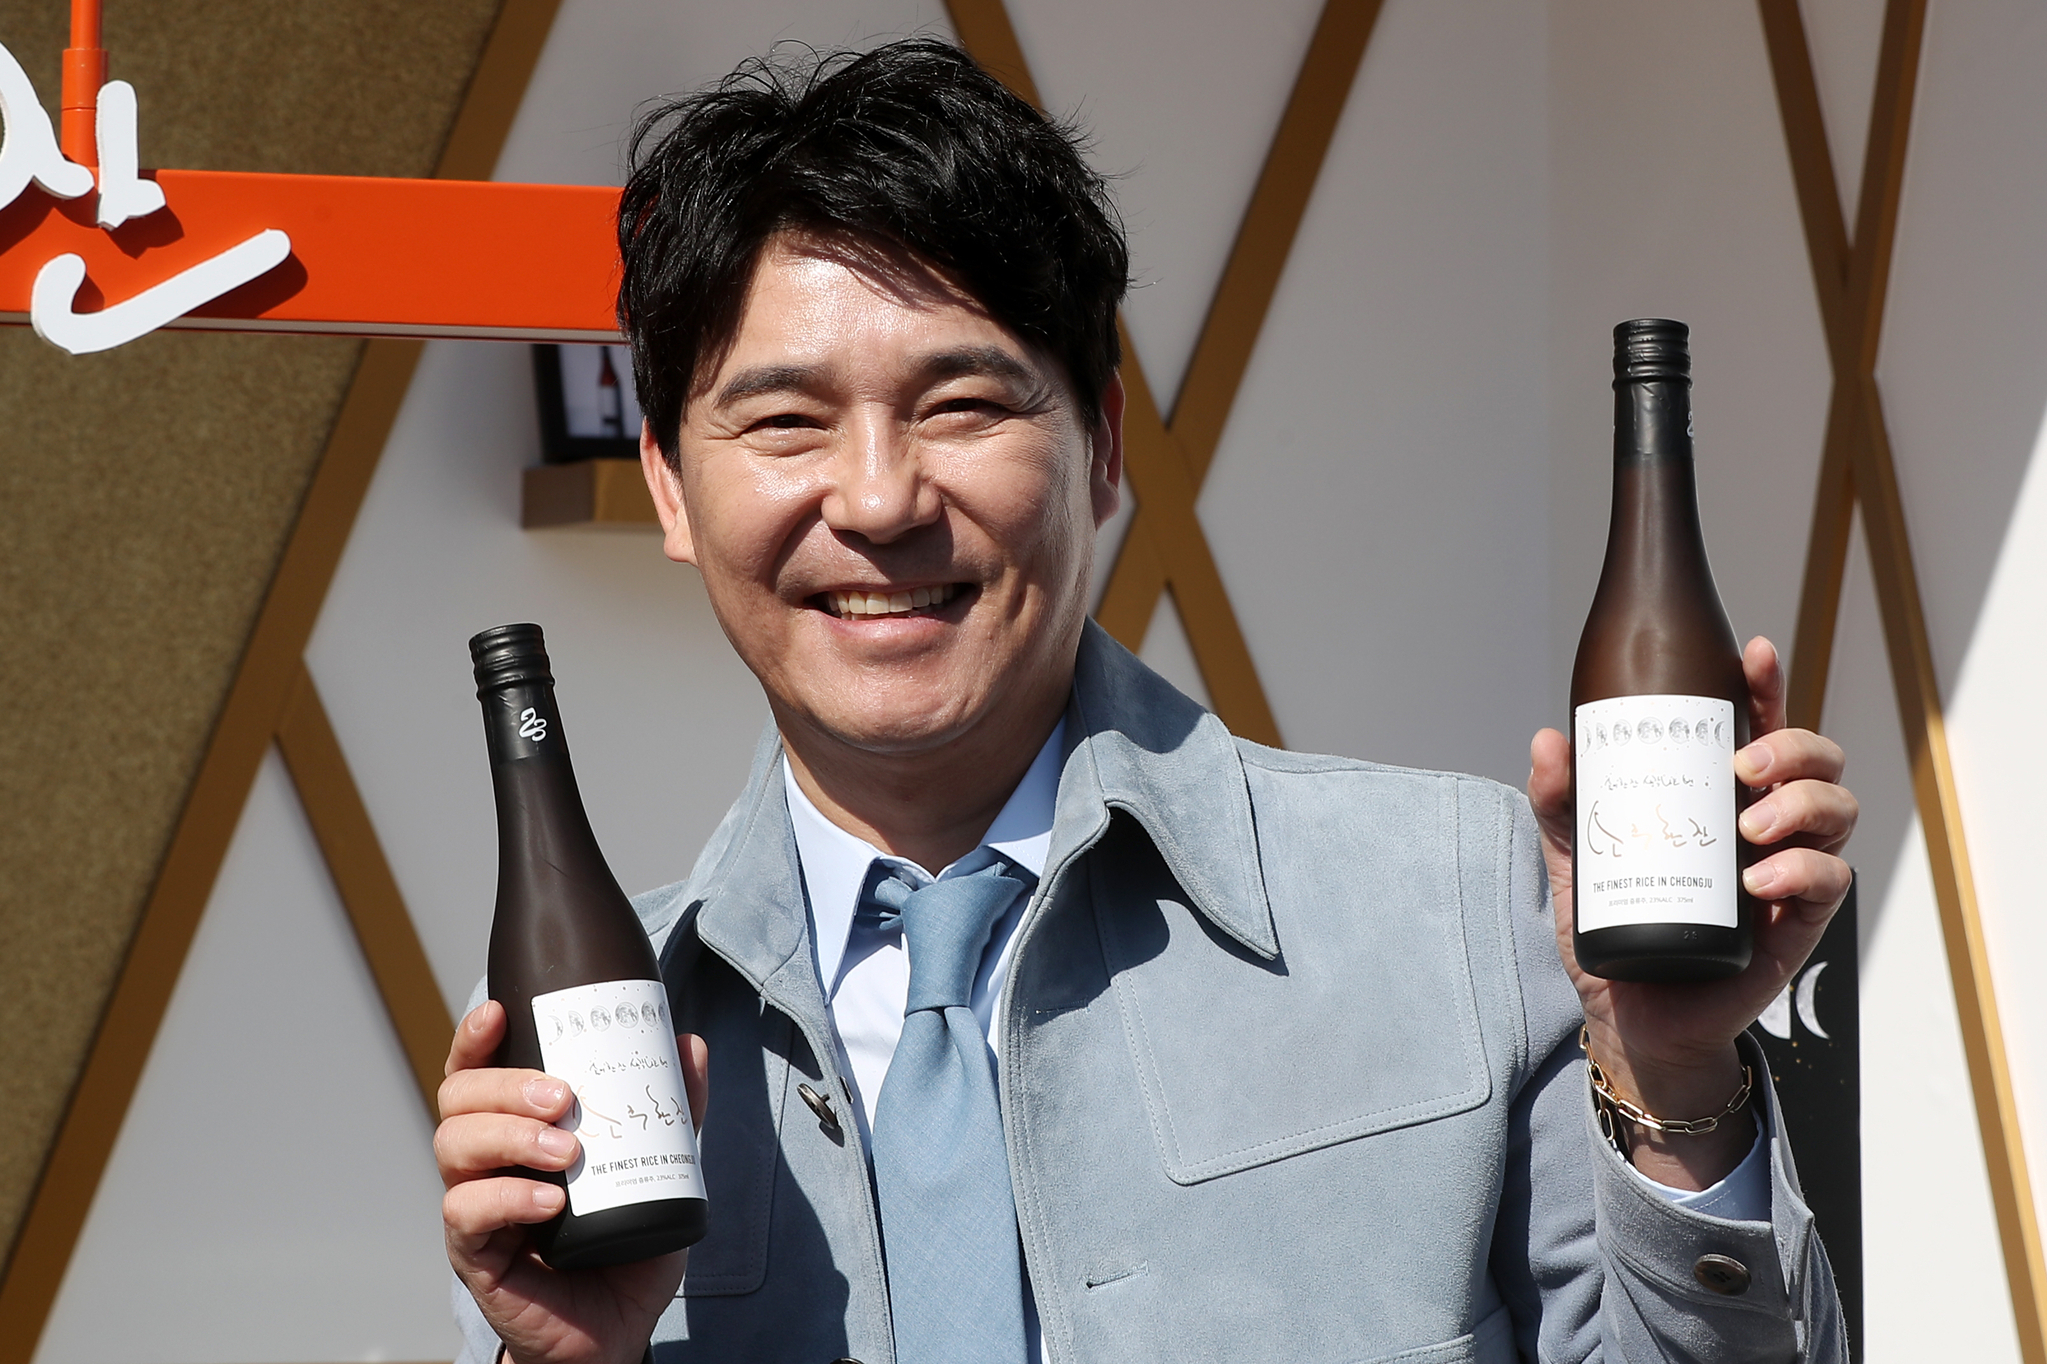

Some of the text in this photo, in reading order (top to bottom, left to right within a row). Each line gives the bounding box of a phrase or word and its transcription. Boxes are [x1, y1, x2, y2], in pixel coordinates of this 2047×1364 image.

[1593, 876, 1713, 893] THE FINEST RICE IN CHEONGJU
[591, 1165, 608, 1177] THE
[609, 1157, 640, 1173] FINEST
[641, 1155, 659, 1168] RICE
[660, 1155, 669, 1166] IN
